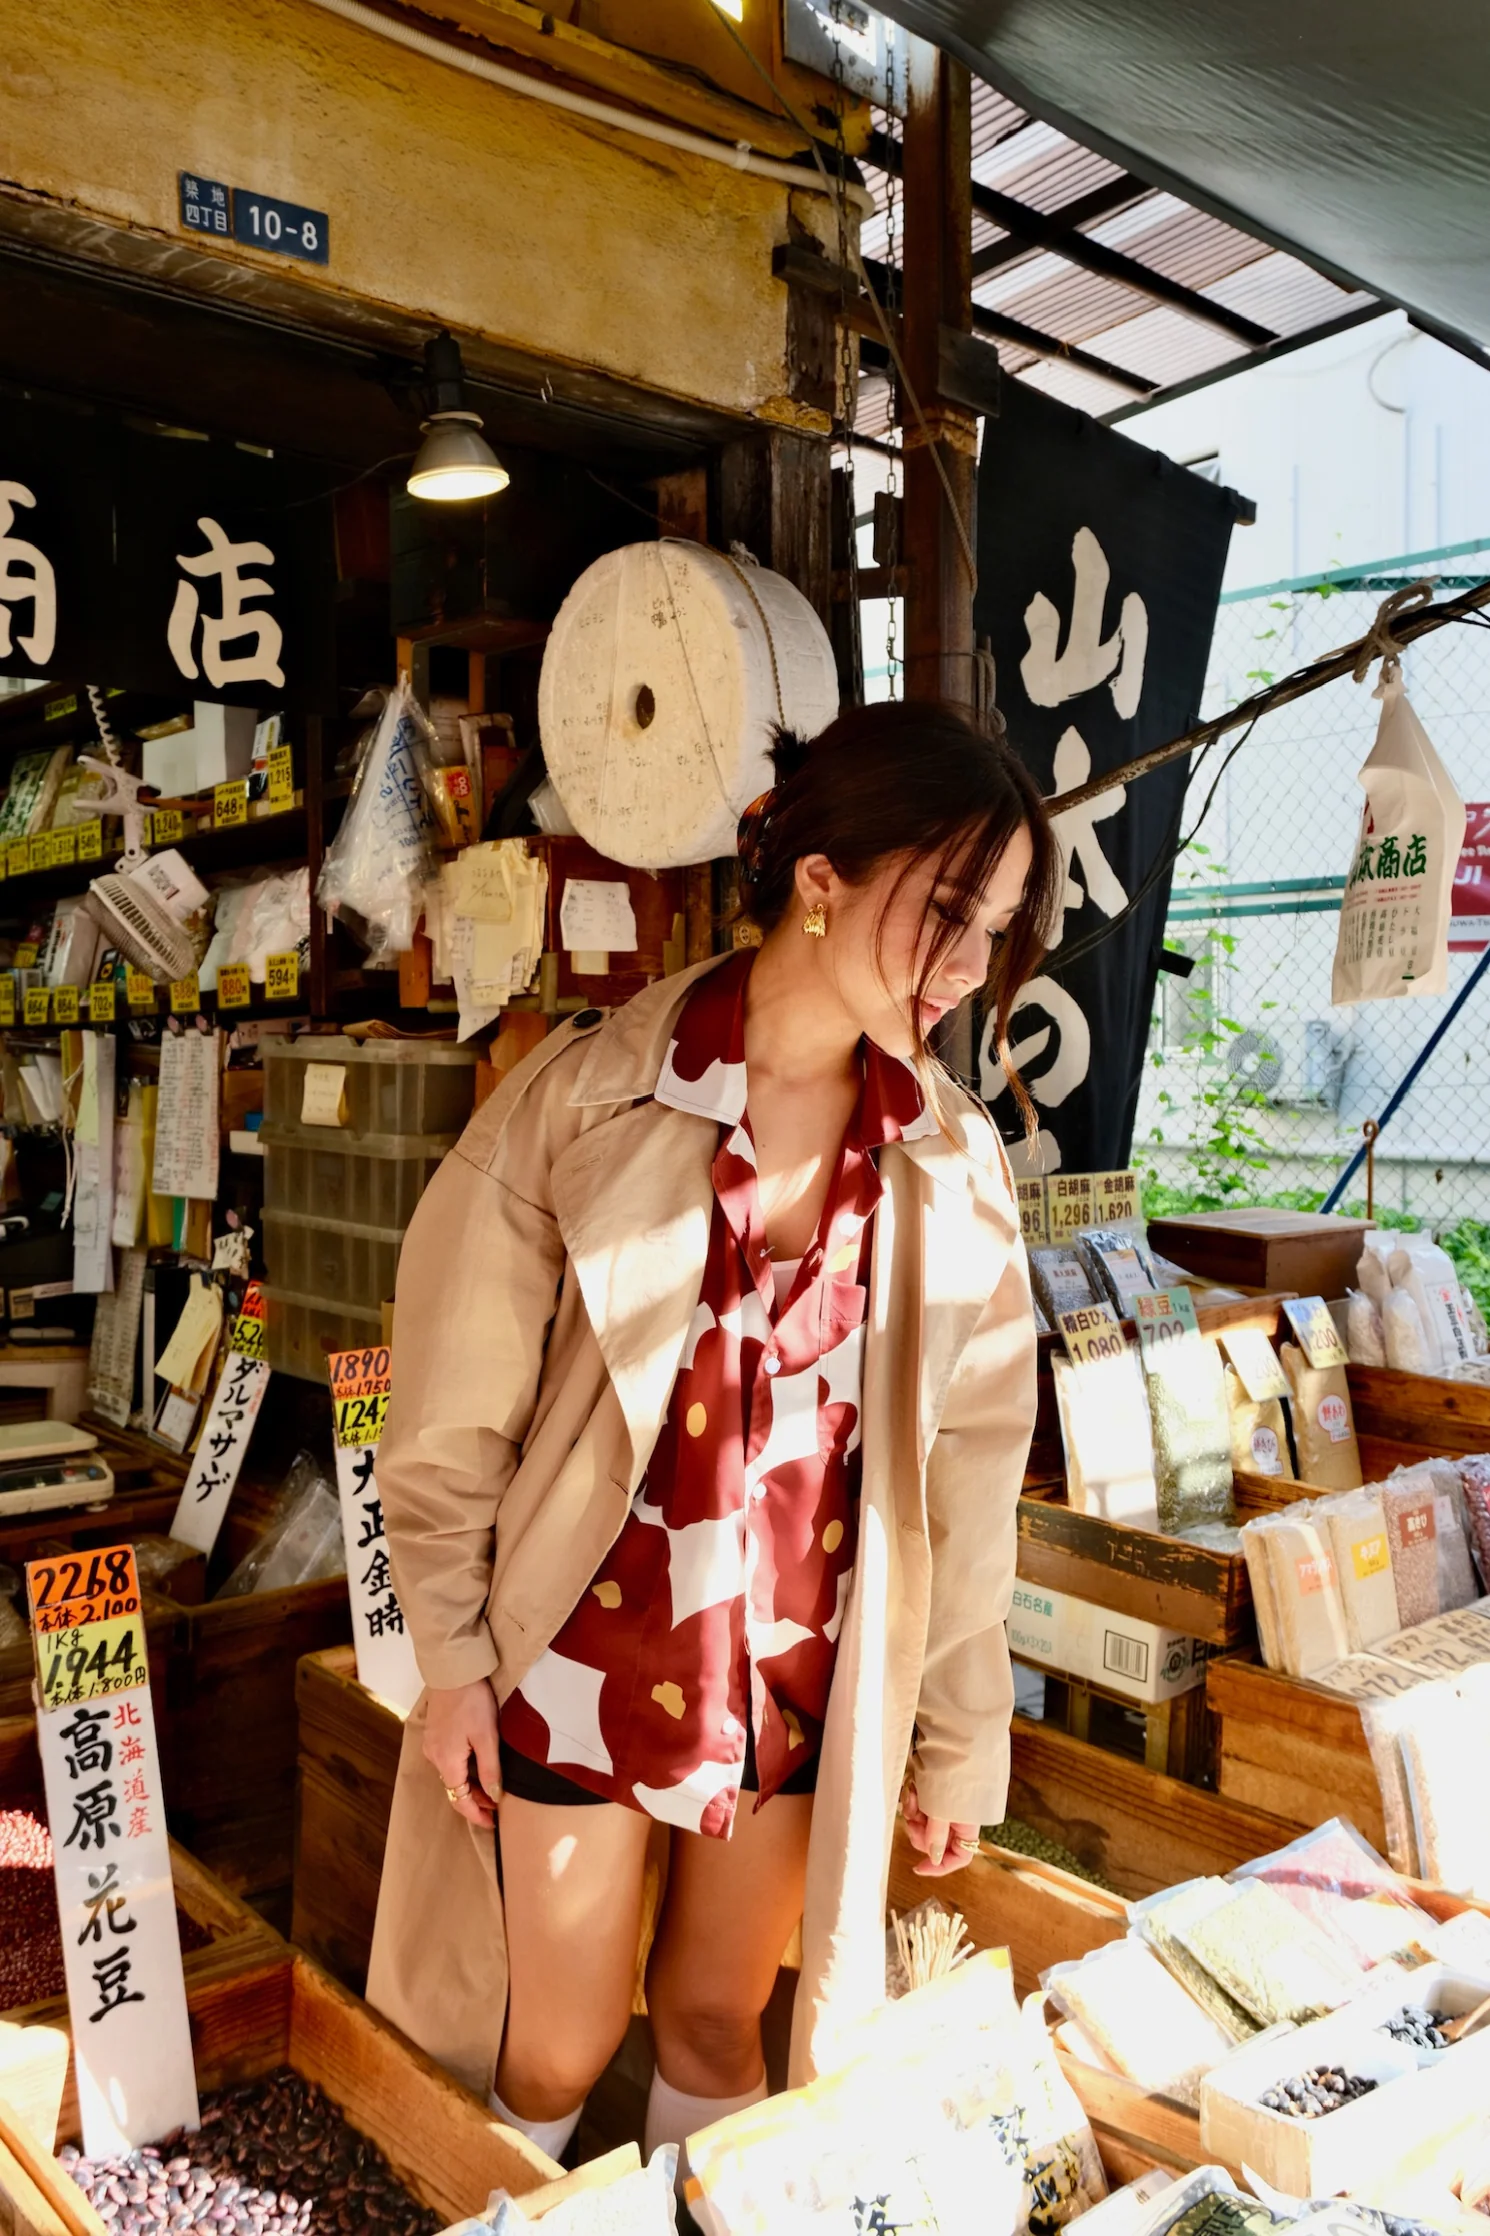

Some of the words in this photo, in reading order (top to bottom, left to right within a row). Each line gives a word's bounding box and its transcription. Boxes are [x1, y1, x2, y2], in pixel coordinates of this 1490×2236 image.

[185, 203, 228, 233] 四丁目
[249, 205, 318, 251] 10-8
[1017, 1182, 1041, 1201] 胡麻
[1057, 1178, 1091, 1197] 白胡麻
[1104, 1175, 1135, 1194] 金胡麻
[1020, 1208, 1041, 1233] 96
[1052, 1202, 1091, 1229] 1,296
[1136, 1293, 1173, 1319] 緑豆
[333, 1348, 390, 1383] 1.890
[44, 1630, 138, 1695] 1.944
[112, 1703, 154, 1841] 北海道産
[59, 1708, 146, 2023] 高原花豆
